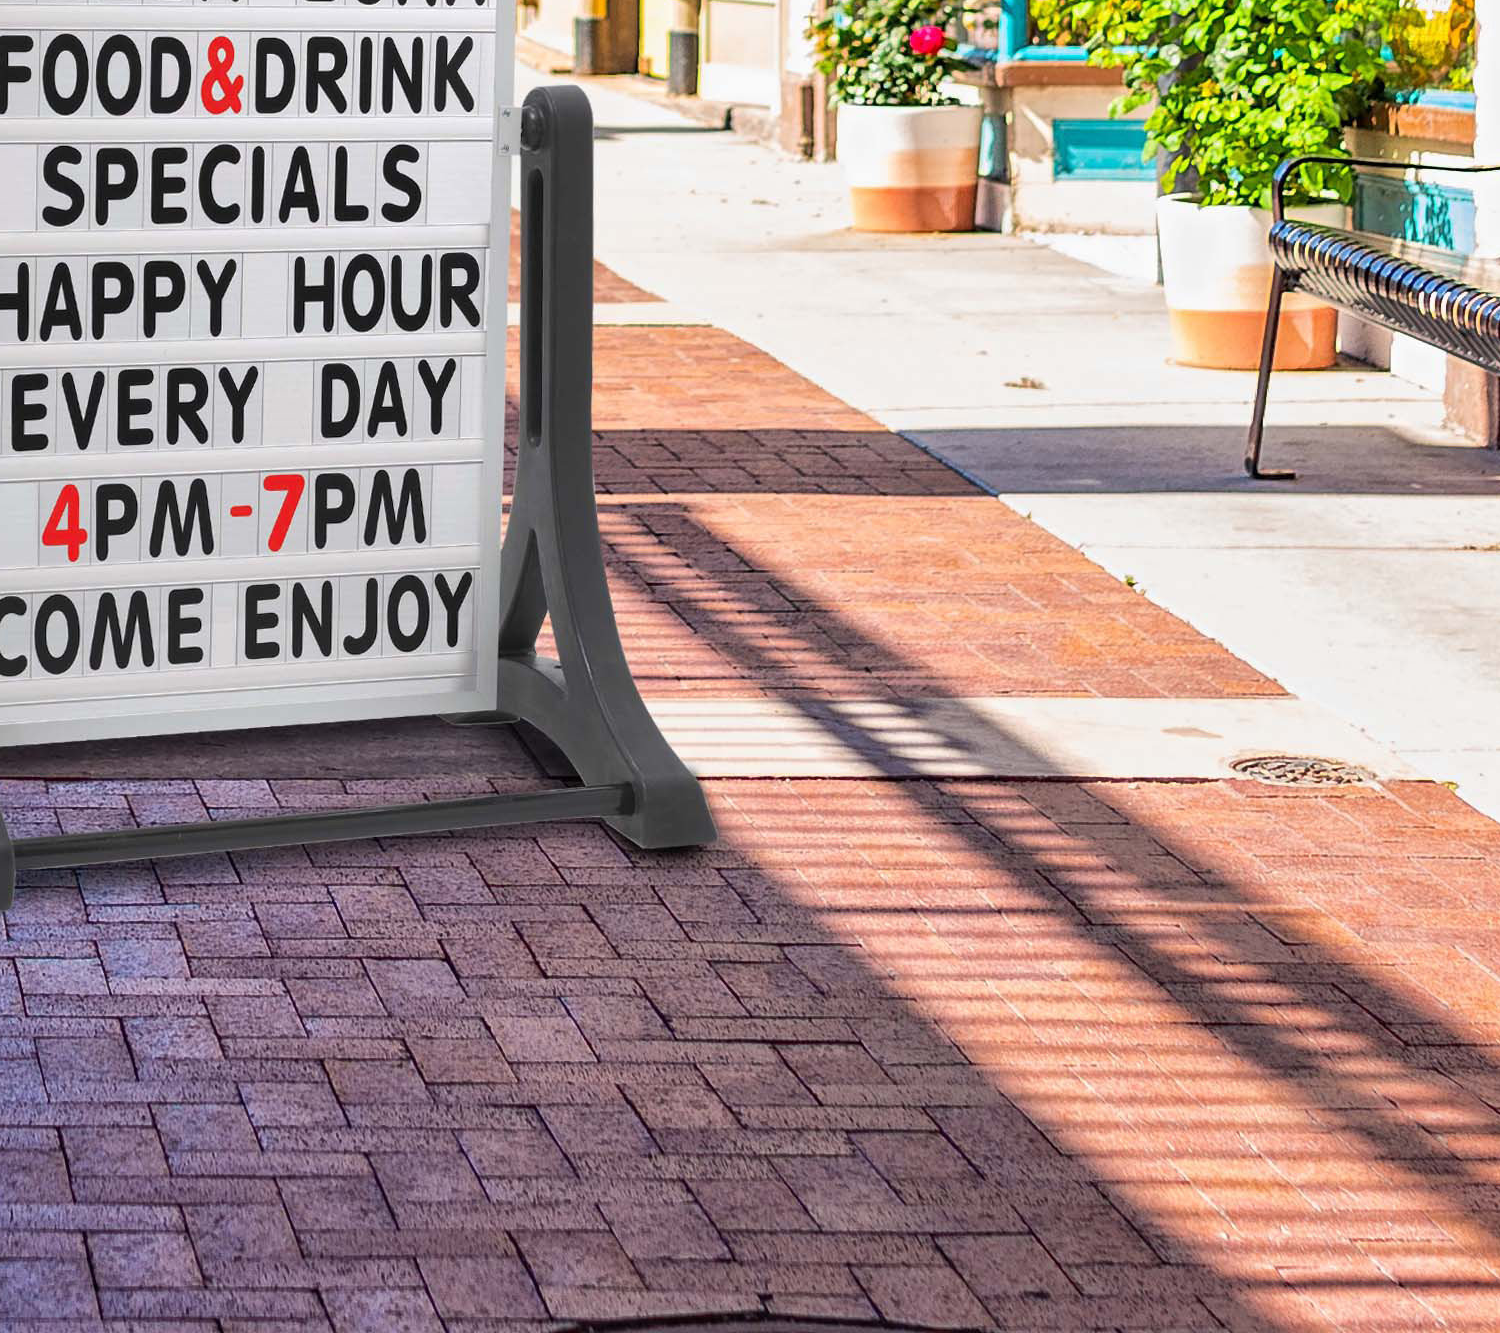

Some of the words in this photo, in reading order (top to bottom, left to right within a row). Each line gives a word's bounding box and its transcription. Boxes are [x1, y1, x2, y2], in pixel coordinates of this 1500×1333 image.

[43, 145, 421, 226] SPECIALS
[294, 253, 480, 333] HOUR
[12, 366, 258, 451] EVERY
[321, 358, 456, 438] DAY
[245, 572, 472, 658] ENJOY
